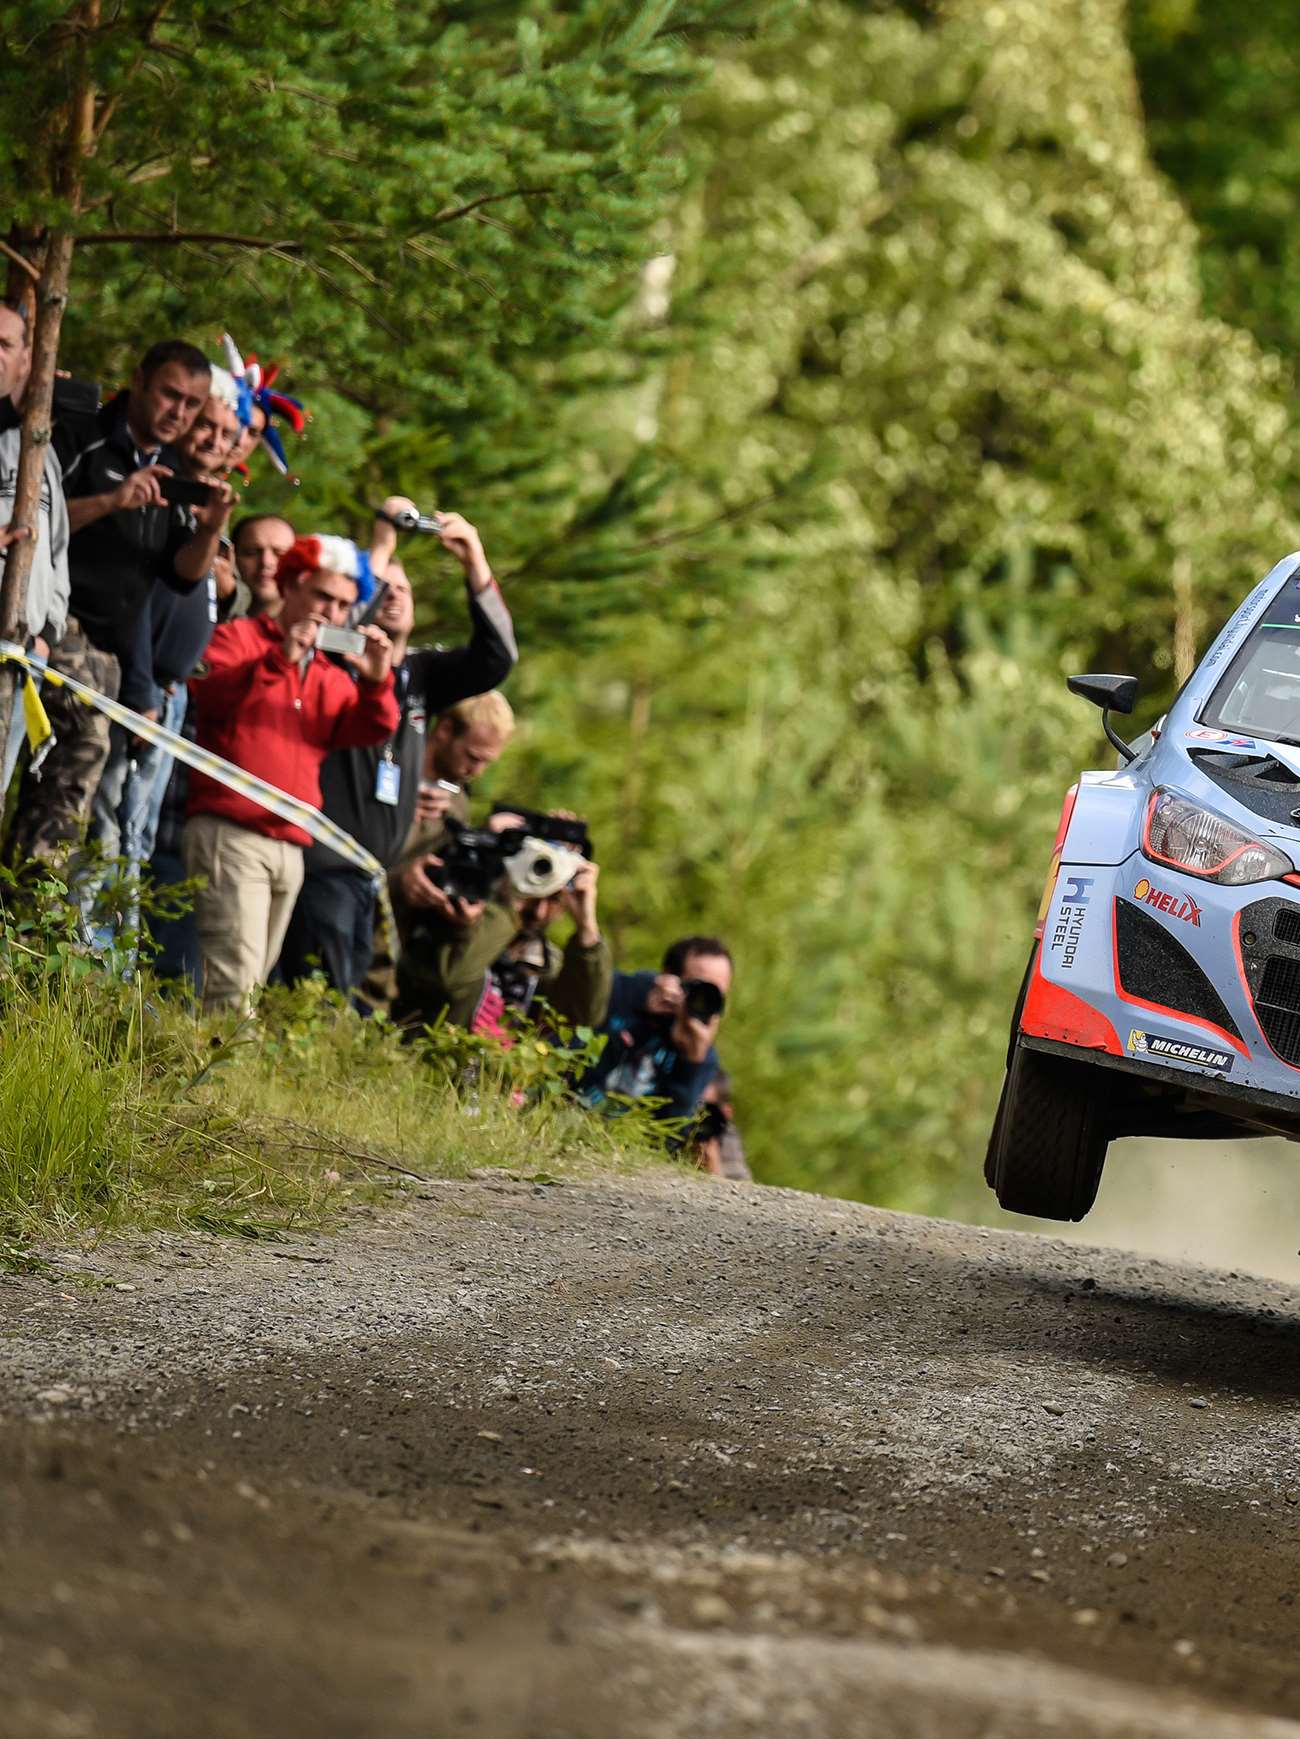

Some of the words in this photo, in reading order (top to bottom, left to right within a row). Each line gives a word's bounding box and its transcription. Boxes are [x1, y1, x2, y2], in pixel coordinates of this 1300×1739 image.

[1051, 906, 1072, 951] STEEL
[1145, 887, 1203, 928] HELIX
[1061, 907, 1086, 969] HYUNDAI
[1150, 1039, 1229, 1067] MICHELIN
